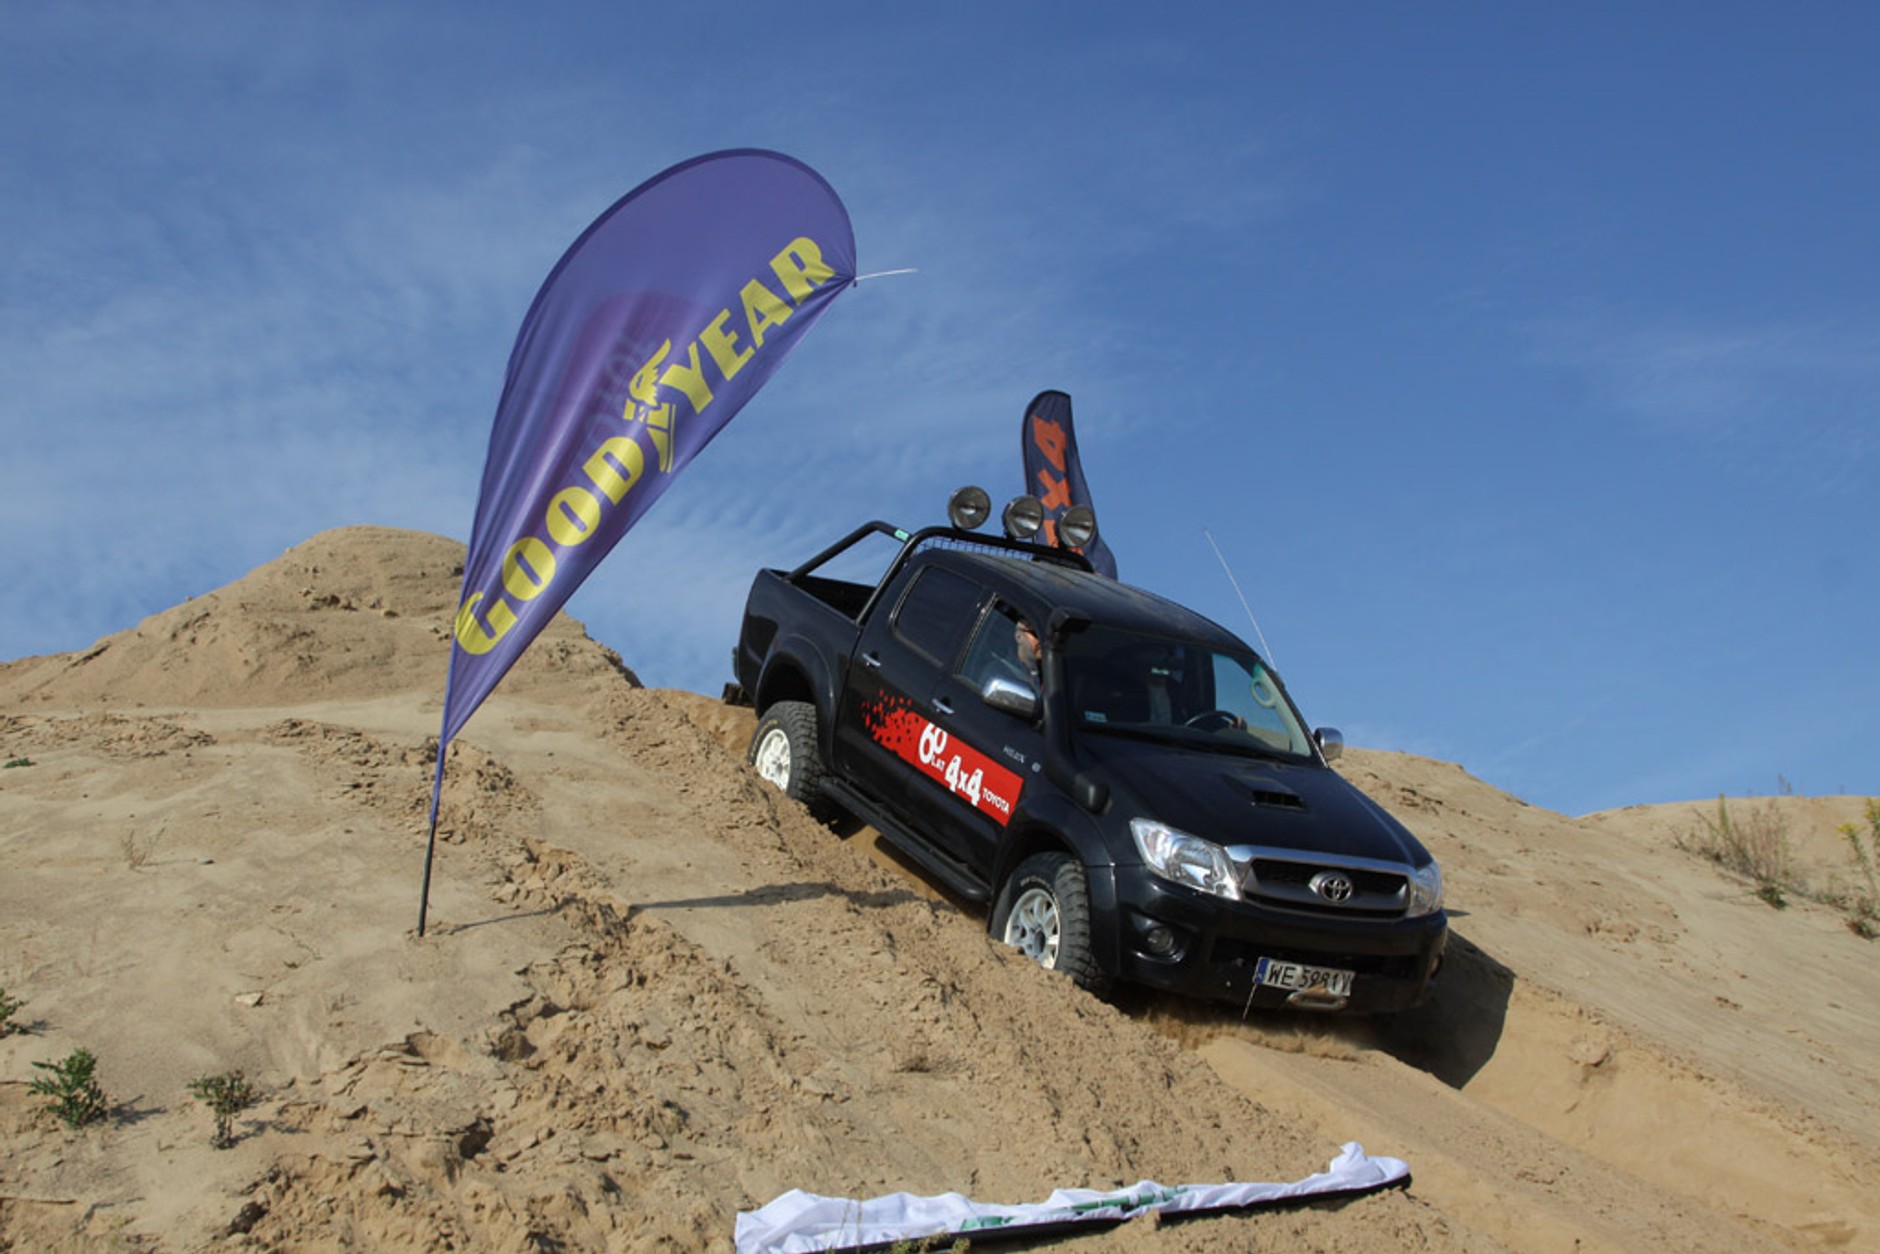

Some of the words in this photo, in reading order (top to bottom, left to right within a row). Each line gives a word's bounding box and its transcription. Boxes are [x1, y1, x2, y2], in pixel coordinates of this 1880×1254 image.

[919, 722, 948, 764] 60
[944, 755, 983, 806] 4x4
[982, 787, 1010, 814] TOYOTA
